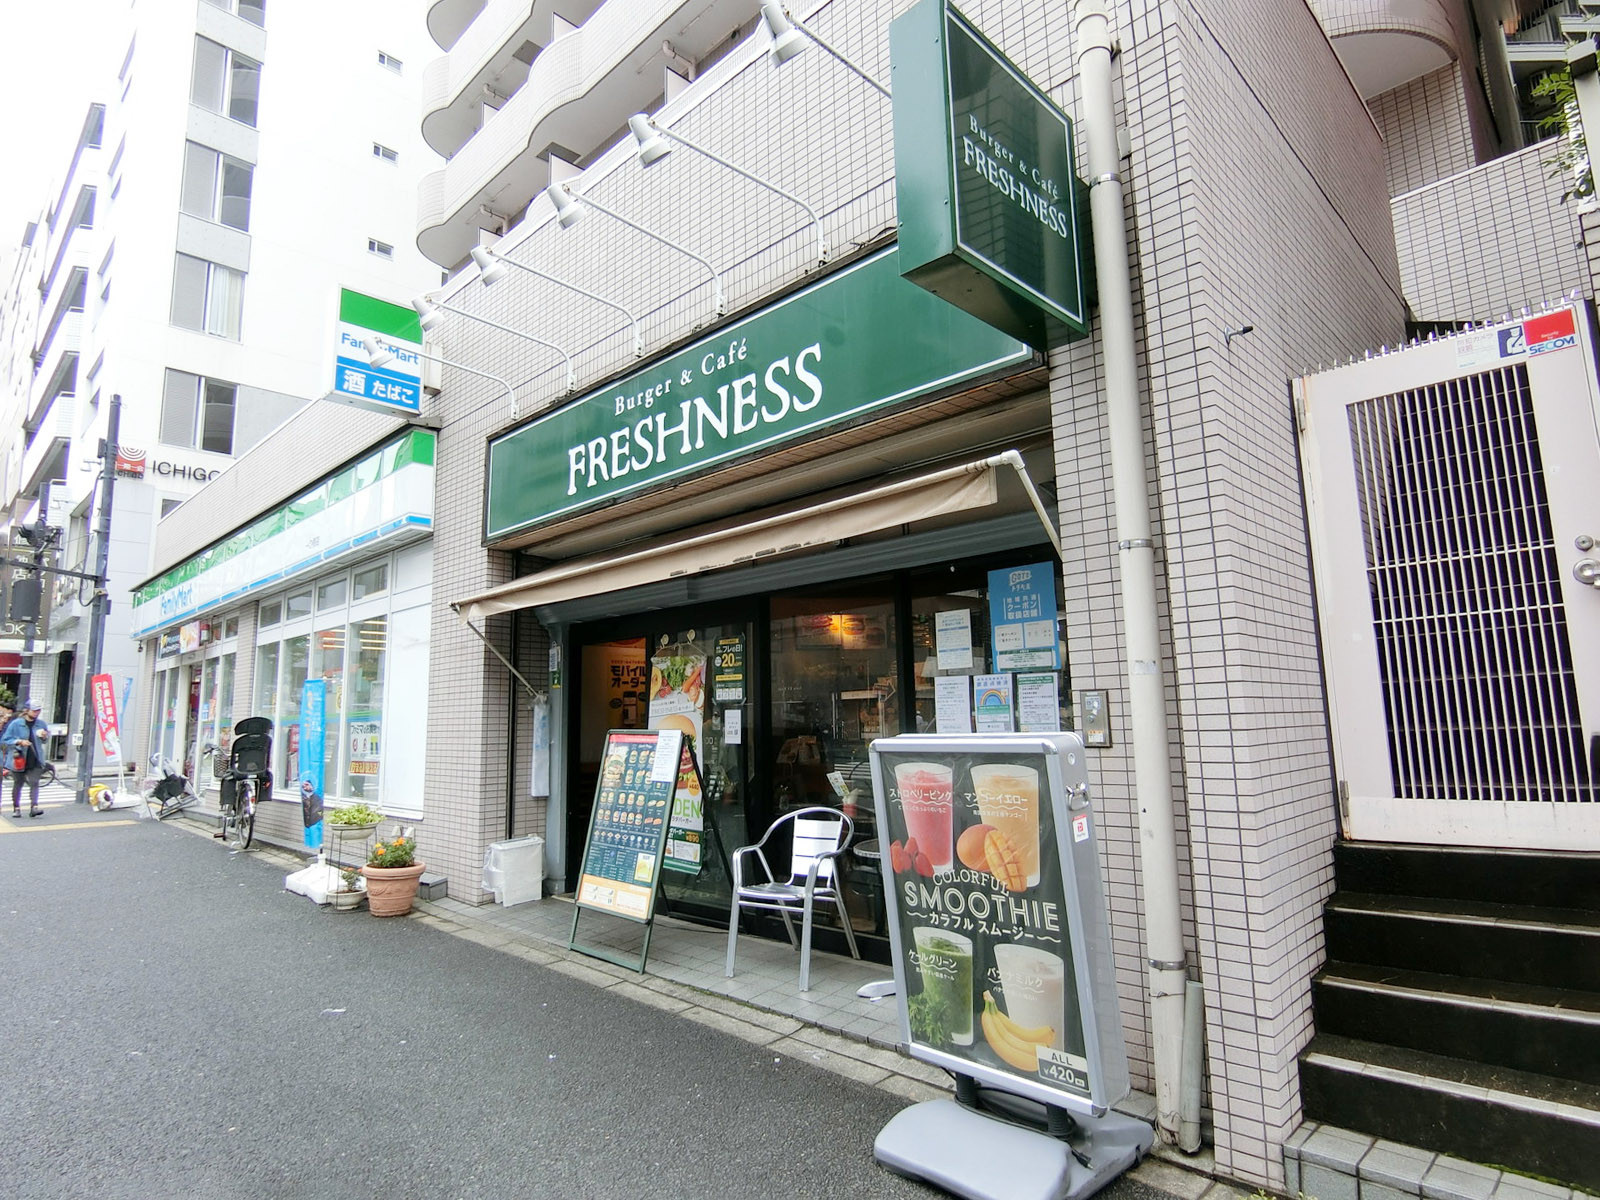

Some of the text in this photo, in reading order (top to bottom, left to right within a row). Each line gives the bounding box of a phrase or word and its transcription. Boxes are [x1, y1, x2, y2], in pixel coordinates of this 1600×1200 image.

[969, 114, 1060, 201] Burger & Café
[963, 135, 1068, 239] FRESHNESS
[1529, 335, 1576, 355] SECOM
[342, 369, 414, 404] 酒 たばこ
[614, 337, 748, 417] Burger & Café
[566, 342, 824, 497] FRESHNESS
[1007, 600, 1038, 612] クーポン
[610, 665, 646, 677] モバイル
[721, 653, 735, 667] 20
[611, 677, 646, 688] オーダー
[963, 792, 1029, 805] マンゴーイエロー
[932, 868, 1010, 898] COLORFUL
[904, 880, 1061, 933] SMOOTHIE
[929, 911, 1036, 941] カラフル スムージー
[908, 948, 958, 969] ケールグリーン
[1051, 1052, 1074, 1067] ALL
